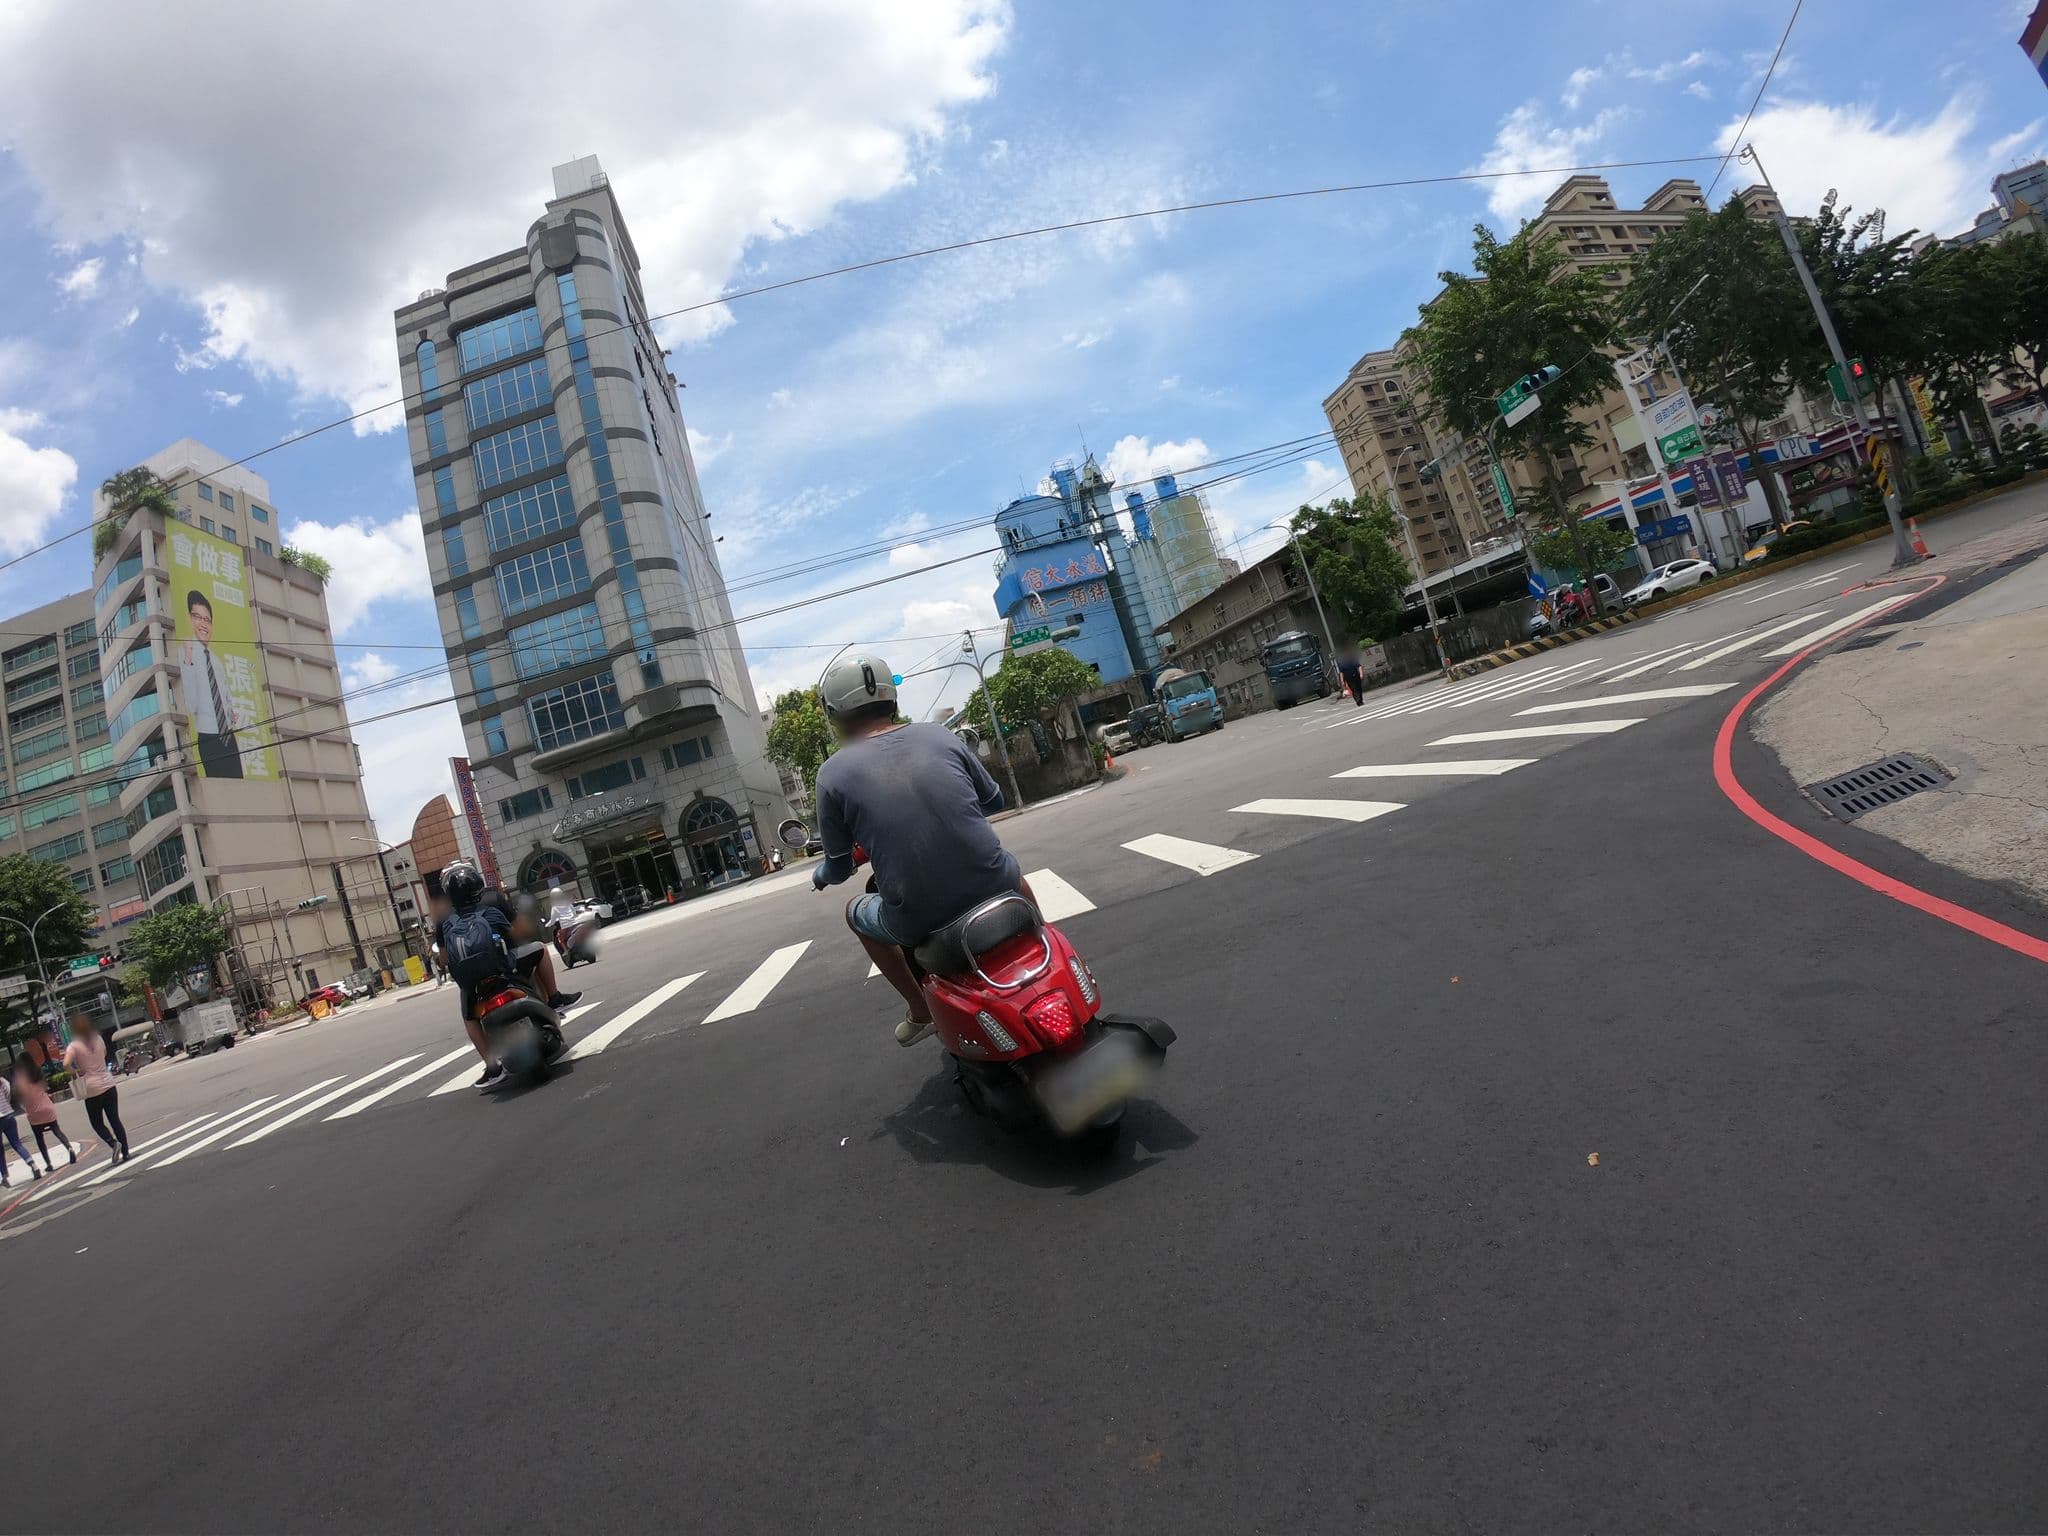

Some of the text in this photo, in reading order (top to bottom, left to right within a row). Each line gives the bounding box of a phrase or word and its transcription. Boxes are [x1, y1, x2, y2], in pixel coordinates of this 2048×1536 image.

[1779, 436, 1808, 459] CPC
[171, 532, 242, 583] 會做事
[1023, 553, 1105, 590] 信大水泥
[1029, 581, 1106, 618] 信一預拌
